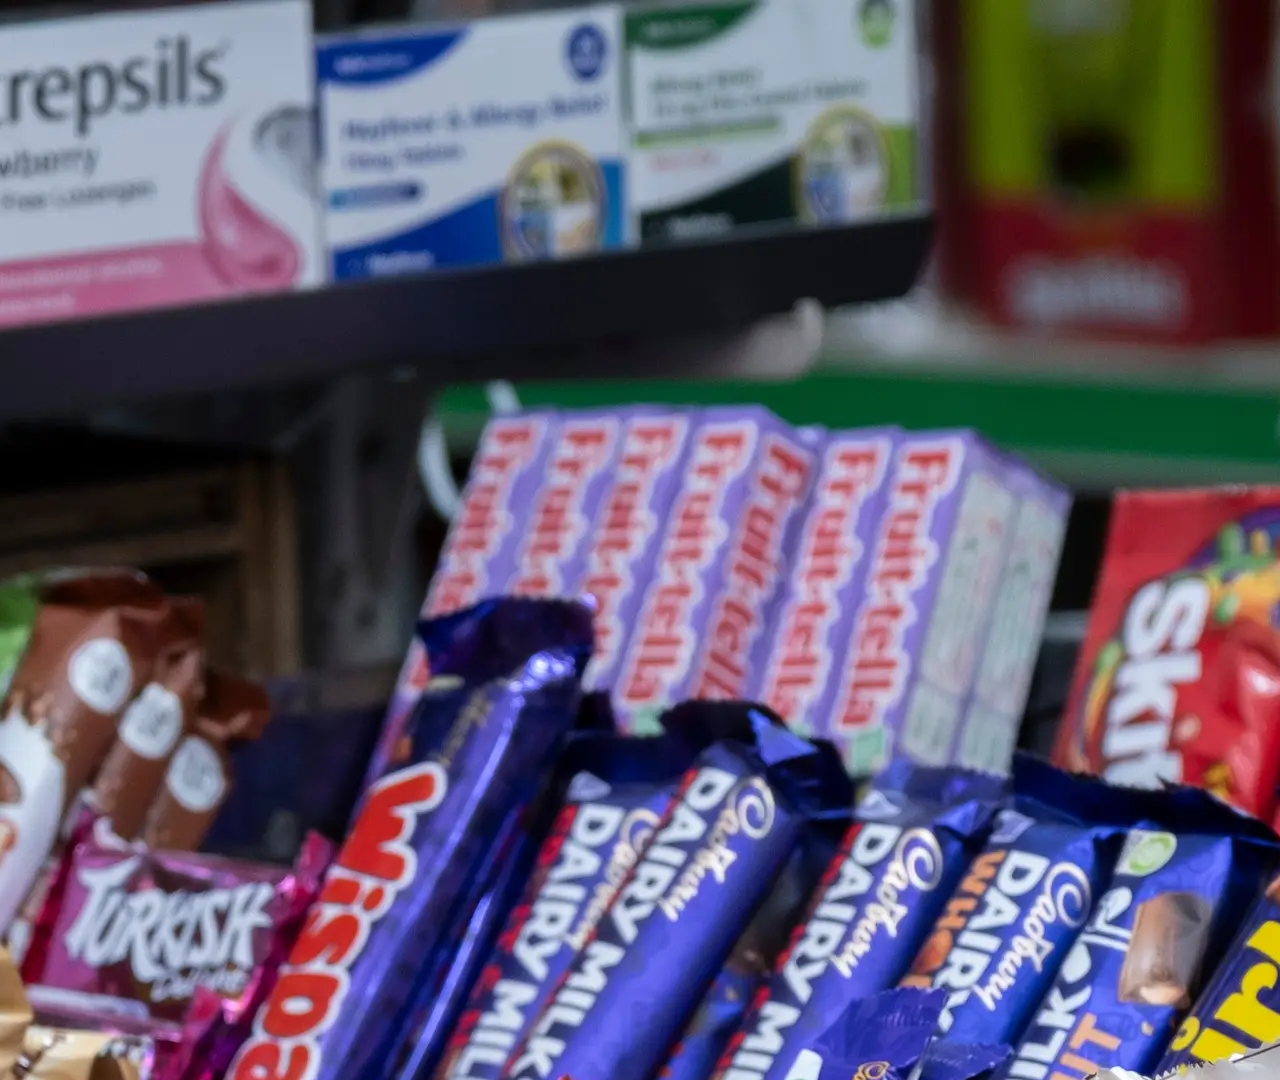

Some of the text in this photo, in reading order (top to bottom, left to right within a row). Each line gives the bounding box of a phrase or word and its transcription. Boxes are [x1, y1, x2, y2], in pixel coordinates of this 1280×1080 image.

[624, 426, 756, 702] Fruit-tella
[839, 445, 958, 727] Fruit-tella
[66, 856, 275, 979] TURKISH
[512, 803, 622, 982] DAIRY
[611, 766, 739, 942] DAIRY
[660, 777, 774, 921] Cadbury
[778, 822, 902, 1004] DAIRY
[832, 829, 943, 979] Cadbury
[974, 861, 1091, 1012] Cadbury
